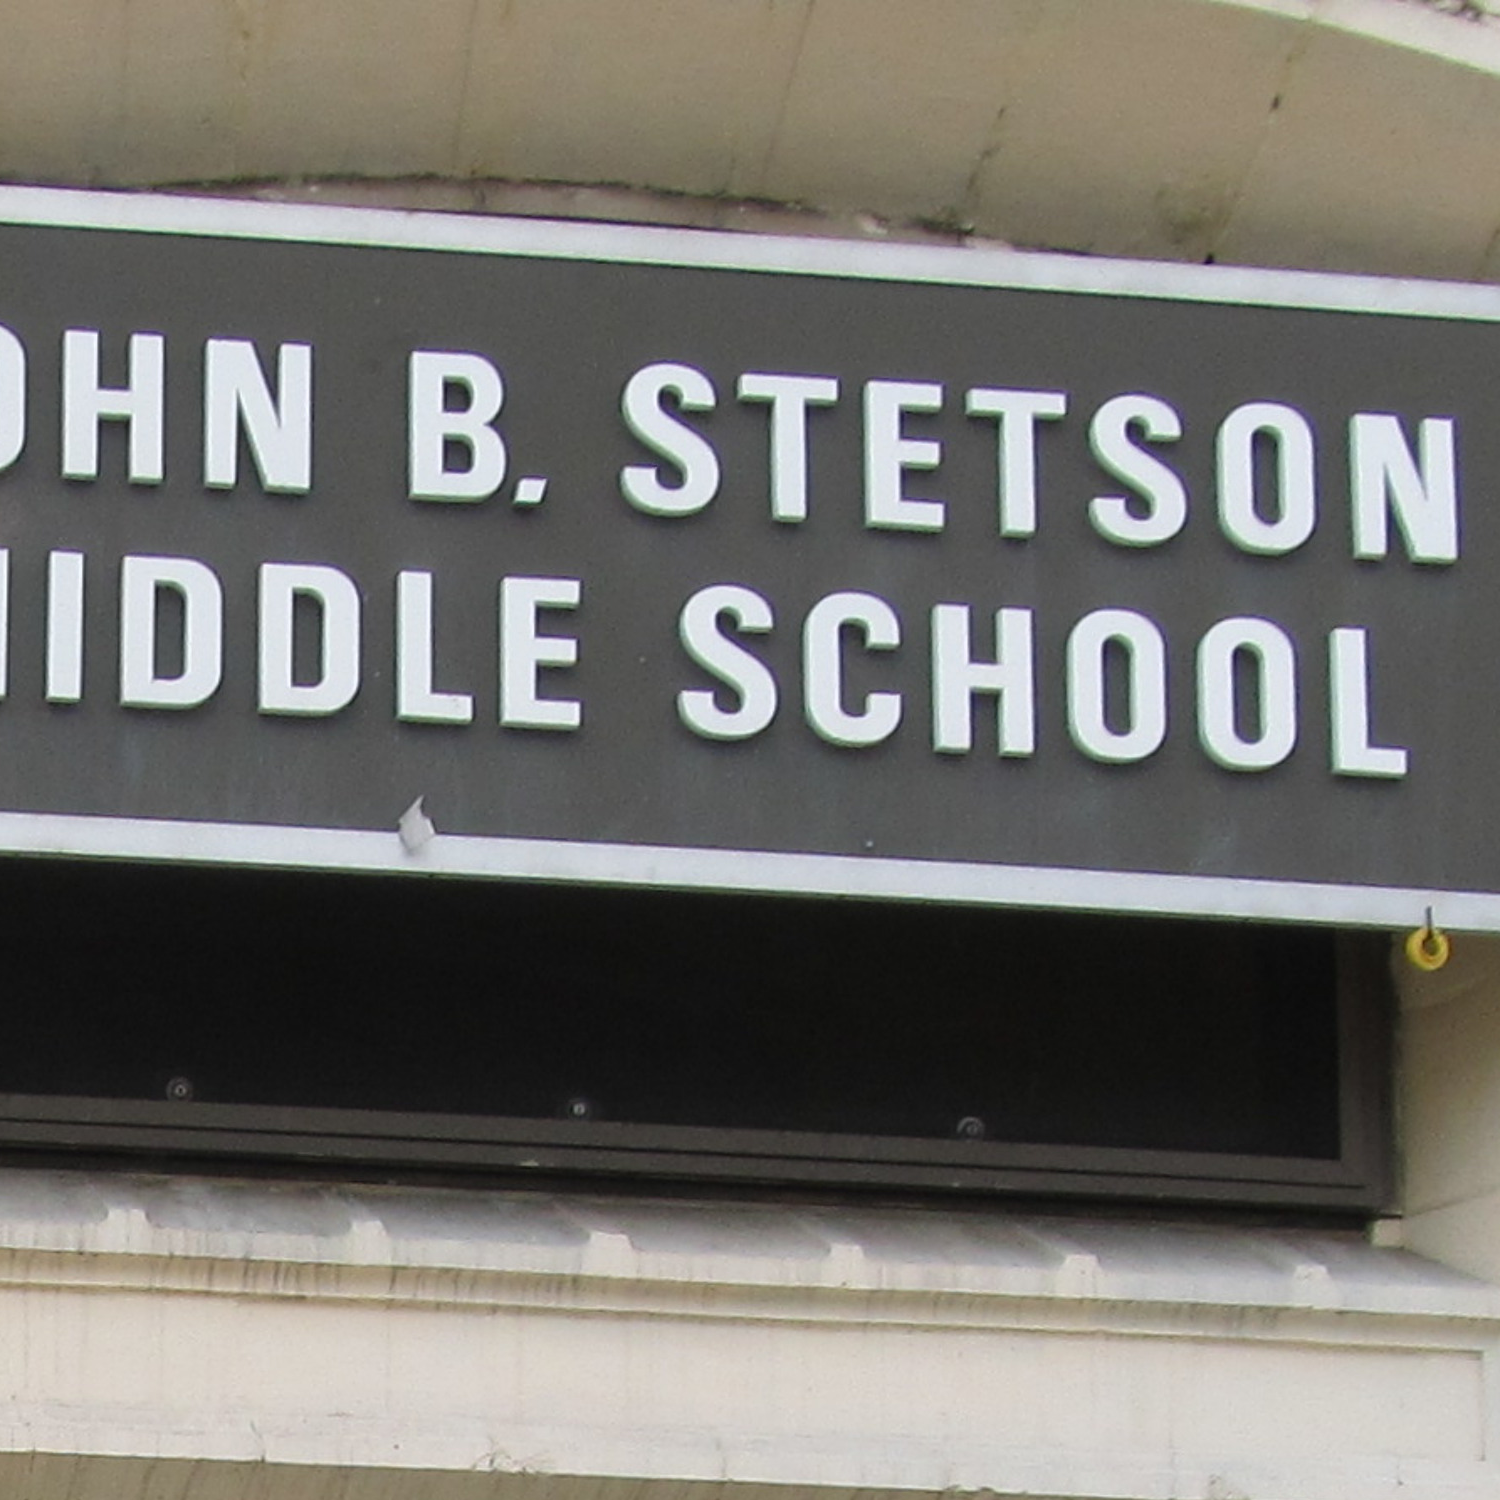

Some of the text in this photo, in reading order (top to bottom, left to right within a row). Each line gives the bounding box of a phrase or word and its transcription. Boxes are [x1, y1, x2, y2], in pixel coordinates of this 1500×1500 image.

[408, 350, 548, 507] B.
[619, 361, 1460, 566] STETSON
[676, 583, 1409, 779] SCHOOL
